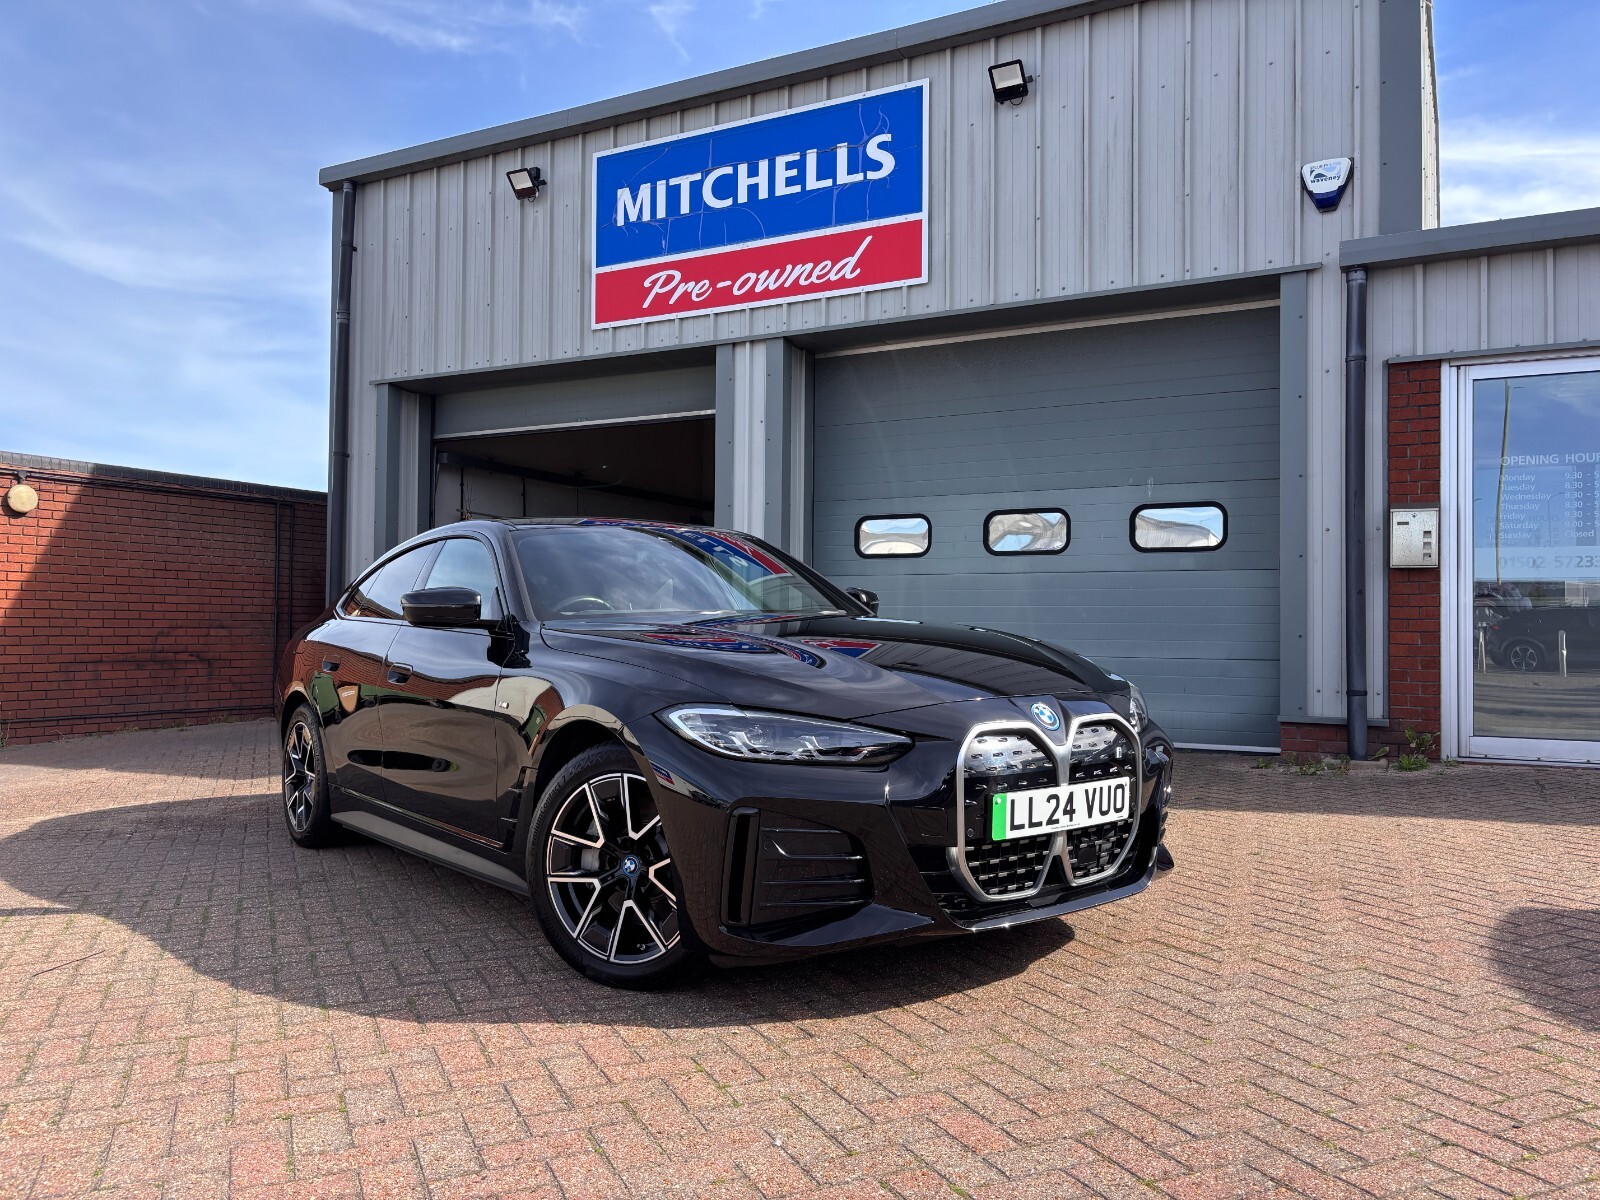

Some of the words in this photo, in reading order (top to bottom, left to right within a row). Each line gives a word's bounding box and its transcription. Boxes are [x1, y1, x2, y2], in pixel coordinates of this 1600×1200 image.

[616, 133, 896, 227] MITCHELLS
[641, 235, 873, 309] Pre-owned
[1501, 454, 1559, 466] OPENING
[1500, 474, 1536, 482] Monday
[1564, 481, 1583, 489] 8.30
[1500, 493, 1552, 501] Wednesday
[1500, 502, 1541, 511] Thursday
[1500, 521, 1539, 530] Saturday
[1564, 520, 1583, 528] 900
[1564, 530, 1594, 538] Closed
[1499, 556, 1546, 569] 01502
[1009, 791, 1076, 832] LL24
[1084, 783, 1126, 819] VUO
